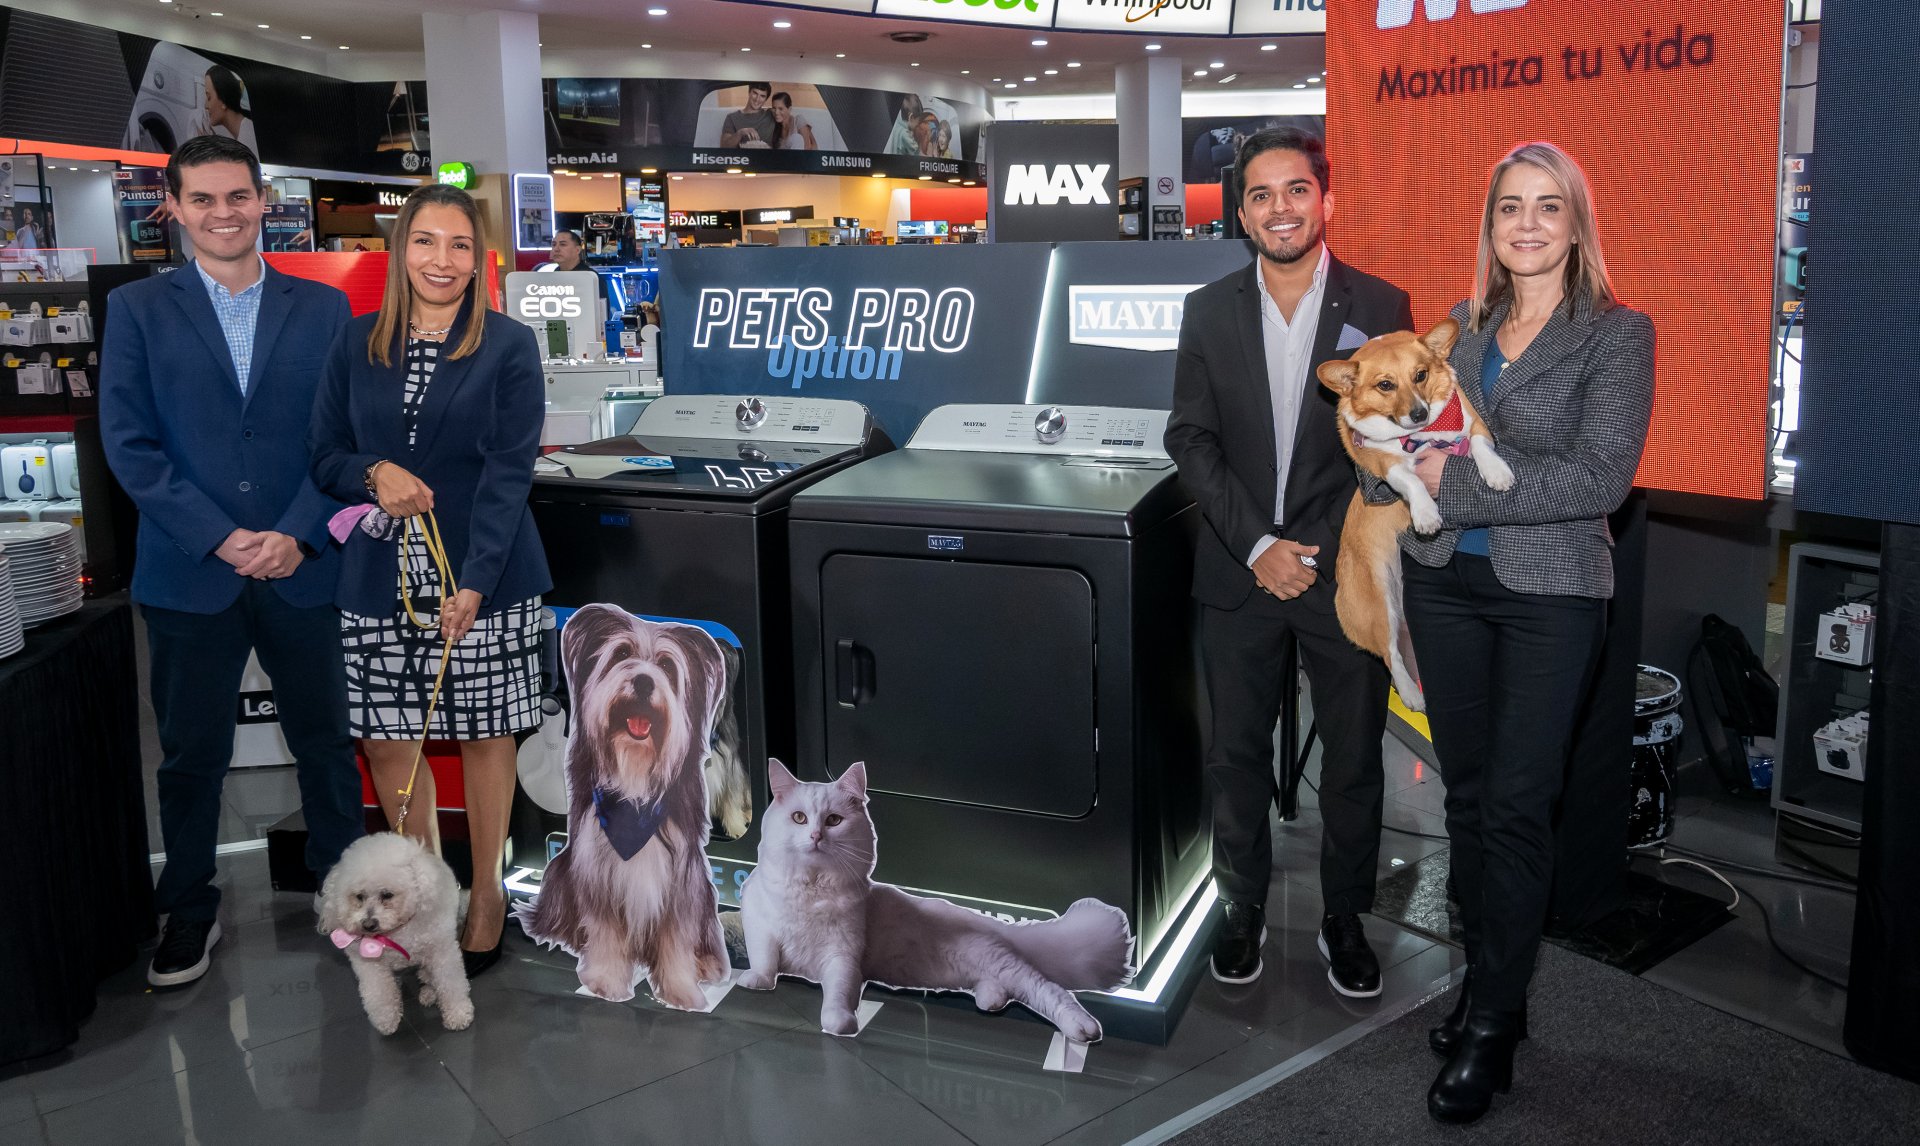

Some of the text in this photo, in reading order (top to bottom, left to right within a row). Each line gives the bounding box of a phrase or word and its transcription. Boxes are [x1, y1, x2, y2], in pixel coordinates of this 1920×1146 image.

[1376, 24, 1715, 102] Maximiza tu vida
[692, 152, 750, 166] Hisense
[821, 155, 872, 168] SAMSUNG
[919, 161, 959, 174] FRIGIDAIRE
[1003, 164, 1111, 205] MAX
[379, 191, 412, 206] Kit
[525, 283, 575, 296] Canon
[520, 296, 581, 318] EOS
[1078, 300, 1184, 331] MAYT
[692, 287, 975, 352] PETS PRO
[767, 334, 903, 389] Option
